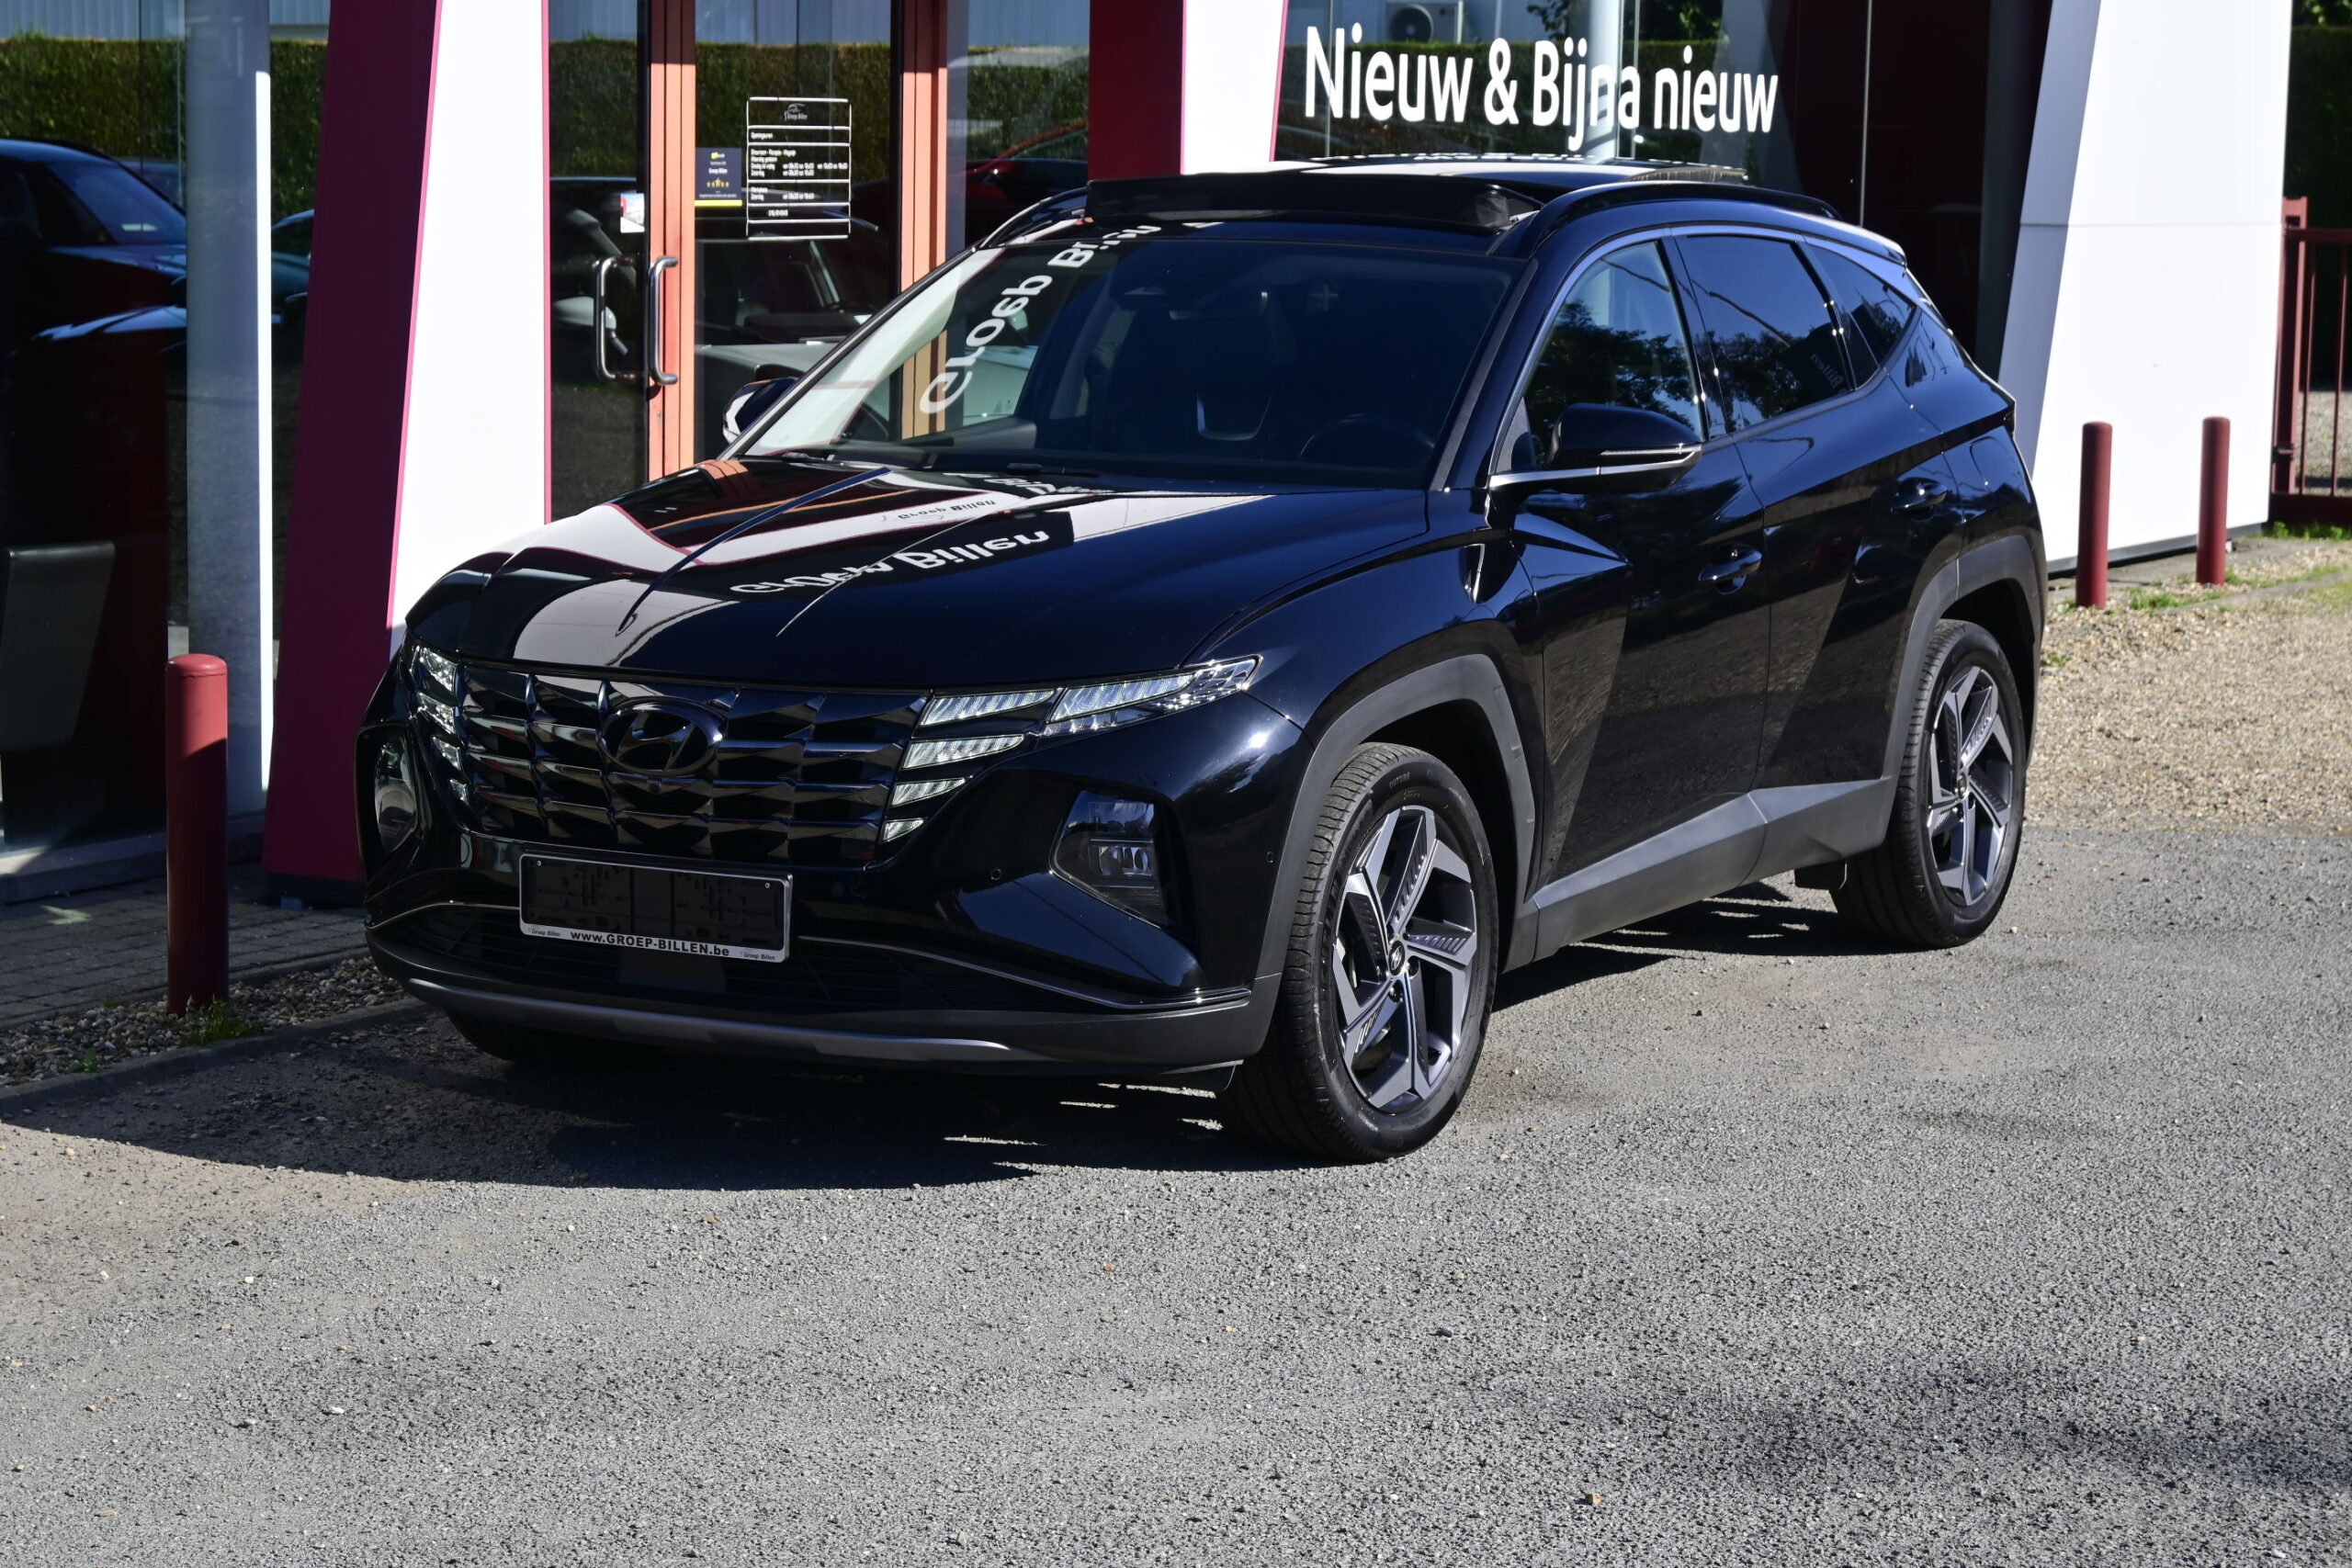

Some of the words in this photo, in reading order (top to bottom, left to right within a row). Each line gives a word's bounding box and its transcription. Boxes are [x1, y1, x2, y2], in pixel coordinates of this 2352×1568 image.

[1305, 22, 1473, 123] Nieuw
[1484, 37, 1520, 126] &
[1532, 37, 1641, 152] Bijna
[1654, 45, 1780, 133] nieuw
[570, 931, 729, 956] www.GROEP-BILLEN.be
